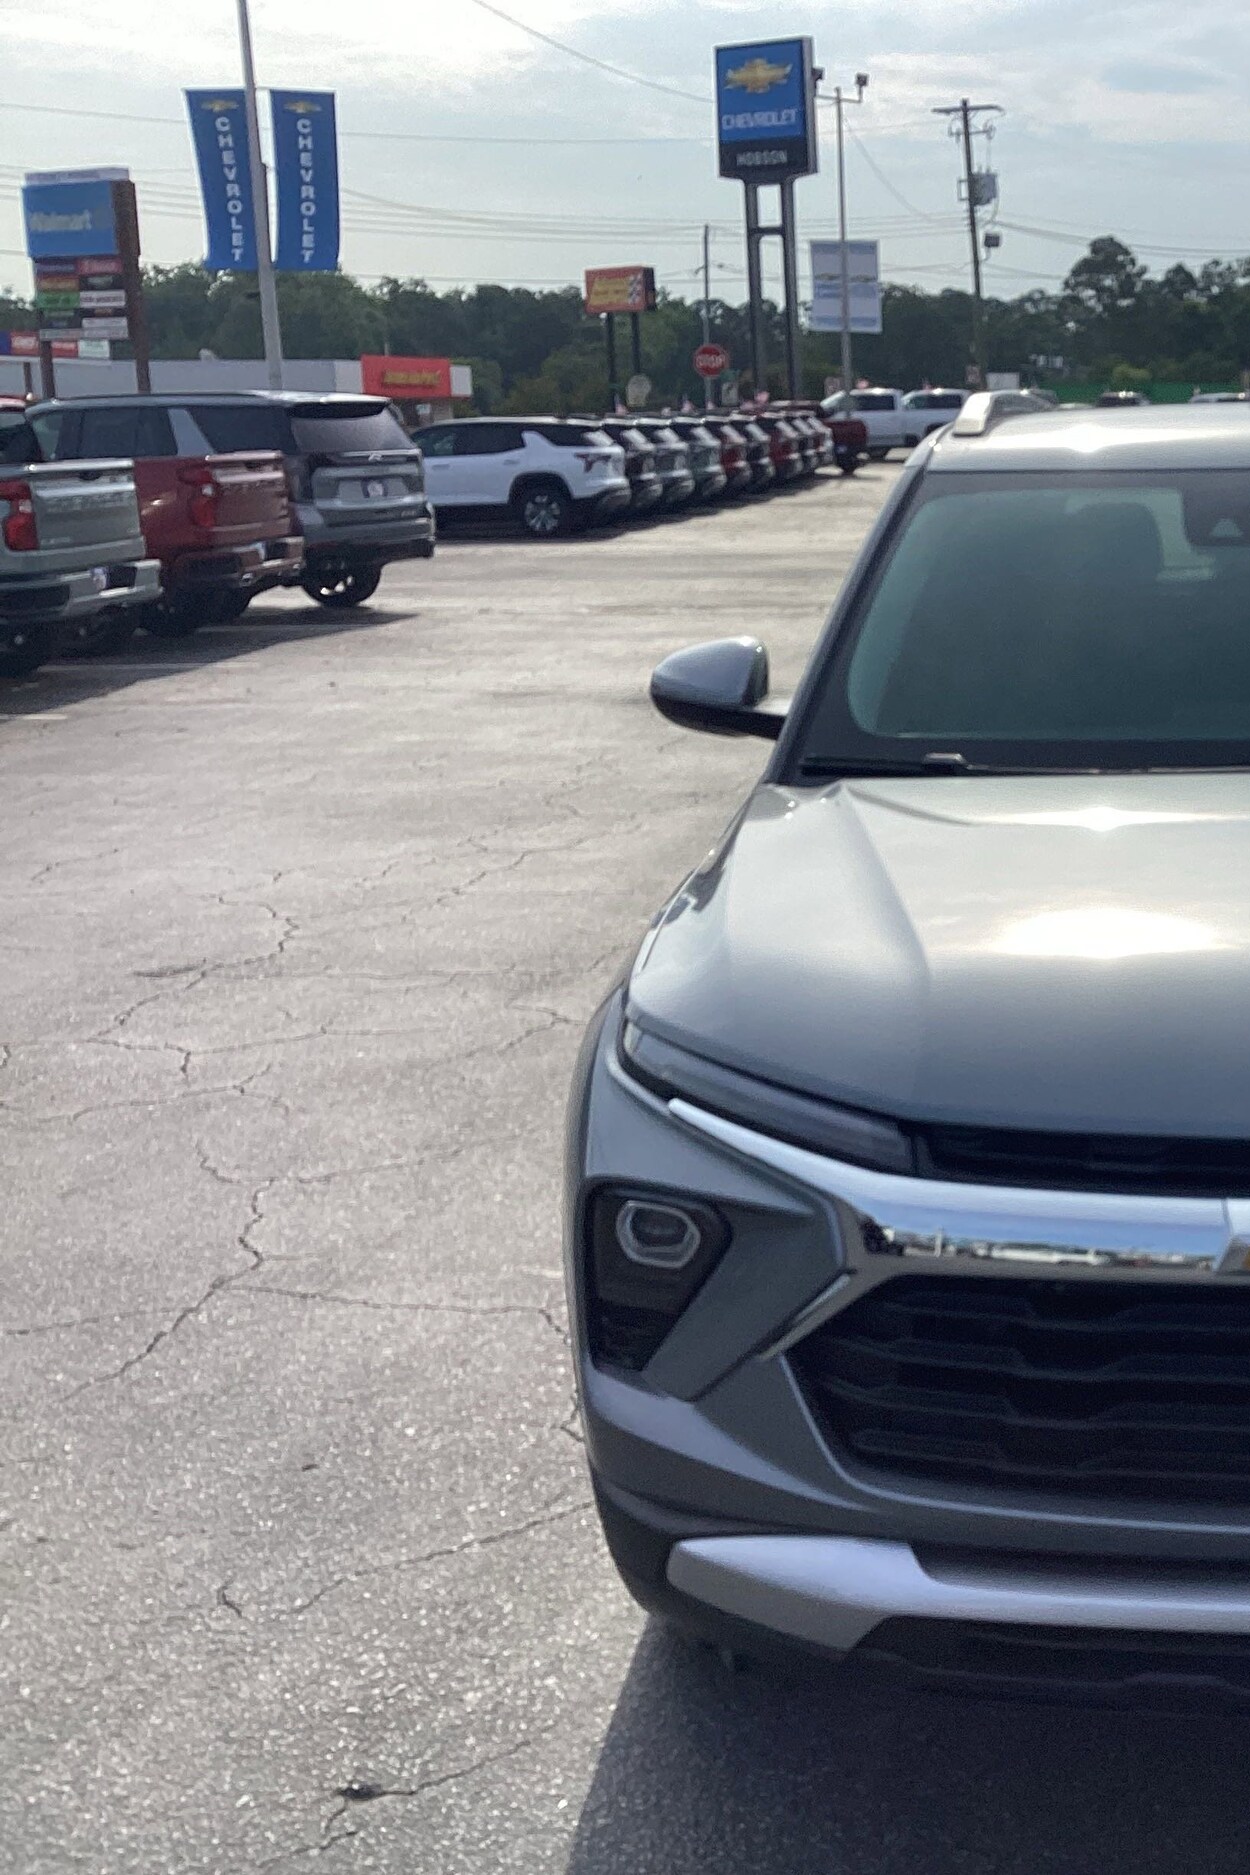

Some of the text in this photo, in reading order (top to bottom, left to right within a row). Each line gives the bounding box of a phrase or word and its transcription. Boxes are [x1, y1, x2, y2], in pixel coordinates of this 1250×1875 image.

[721, 108, 798, 130] CHEVROLET
[214, 116, 244, 262] CHEVROLET
[296, 118, 316, 263] CHEVROLET
[695, 353, 726, 368] STOP
